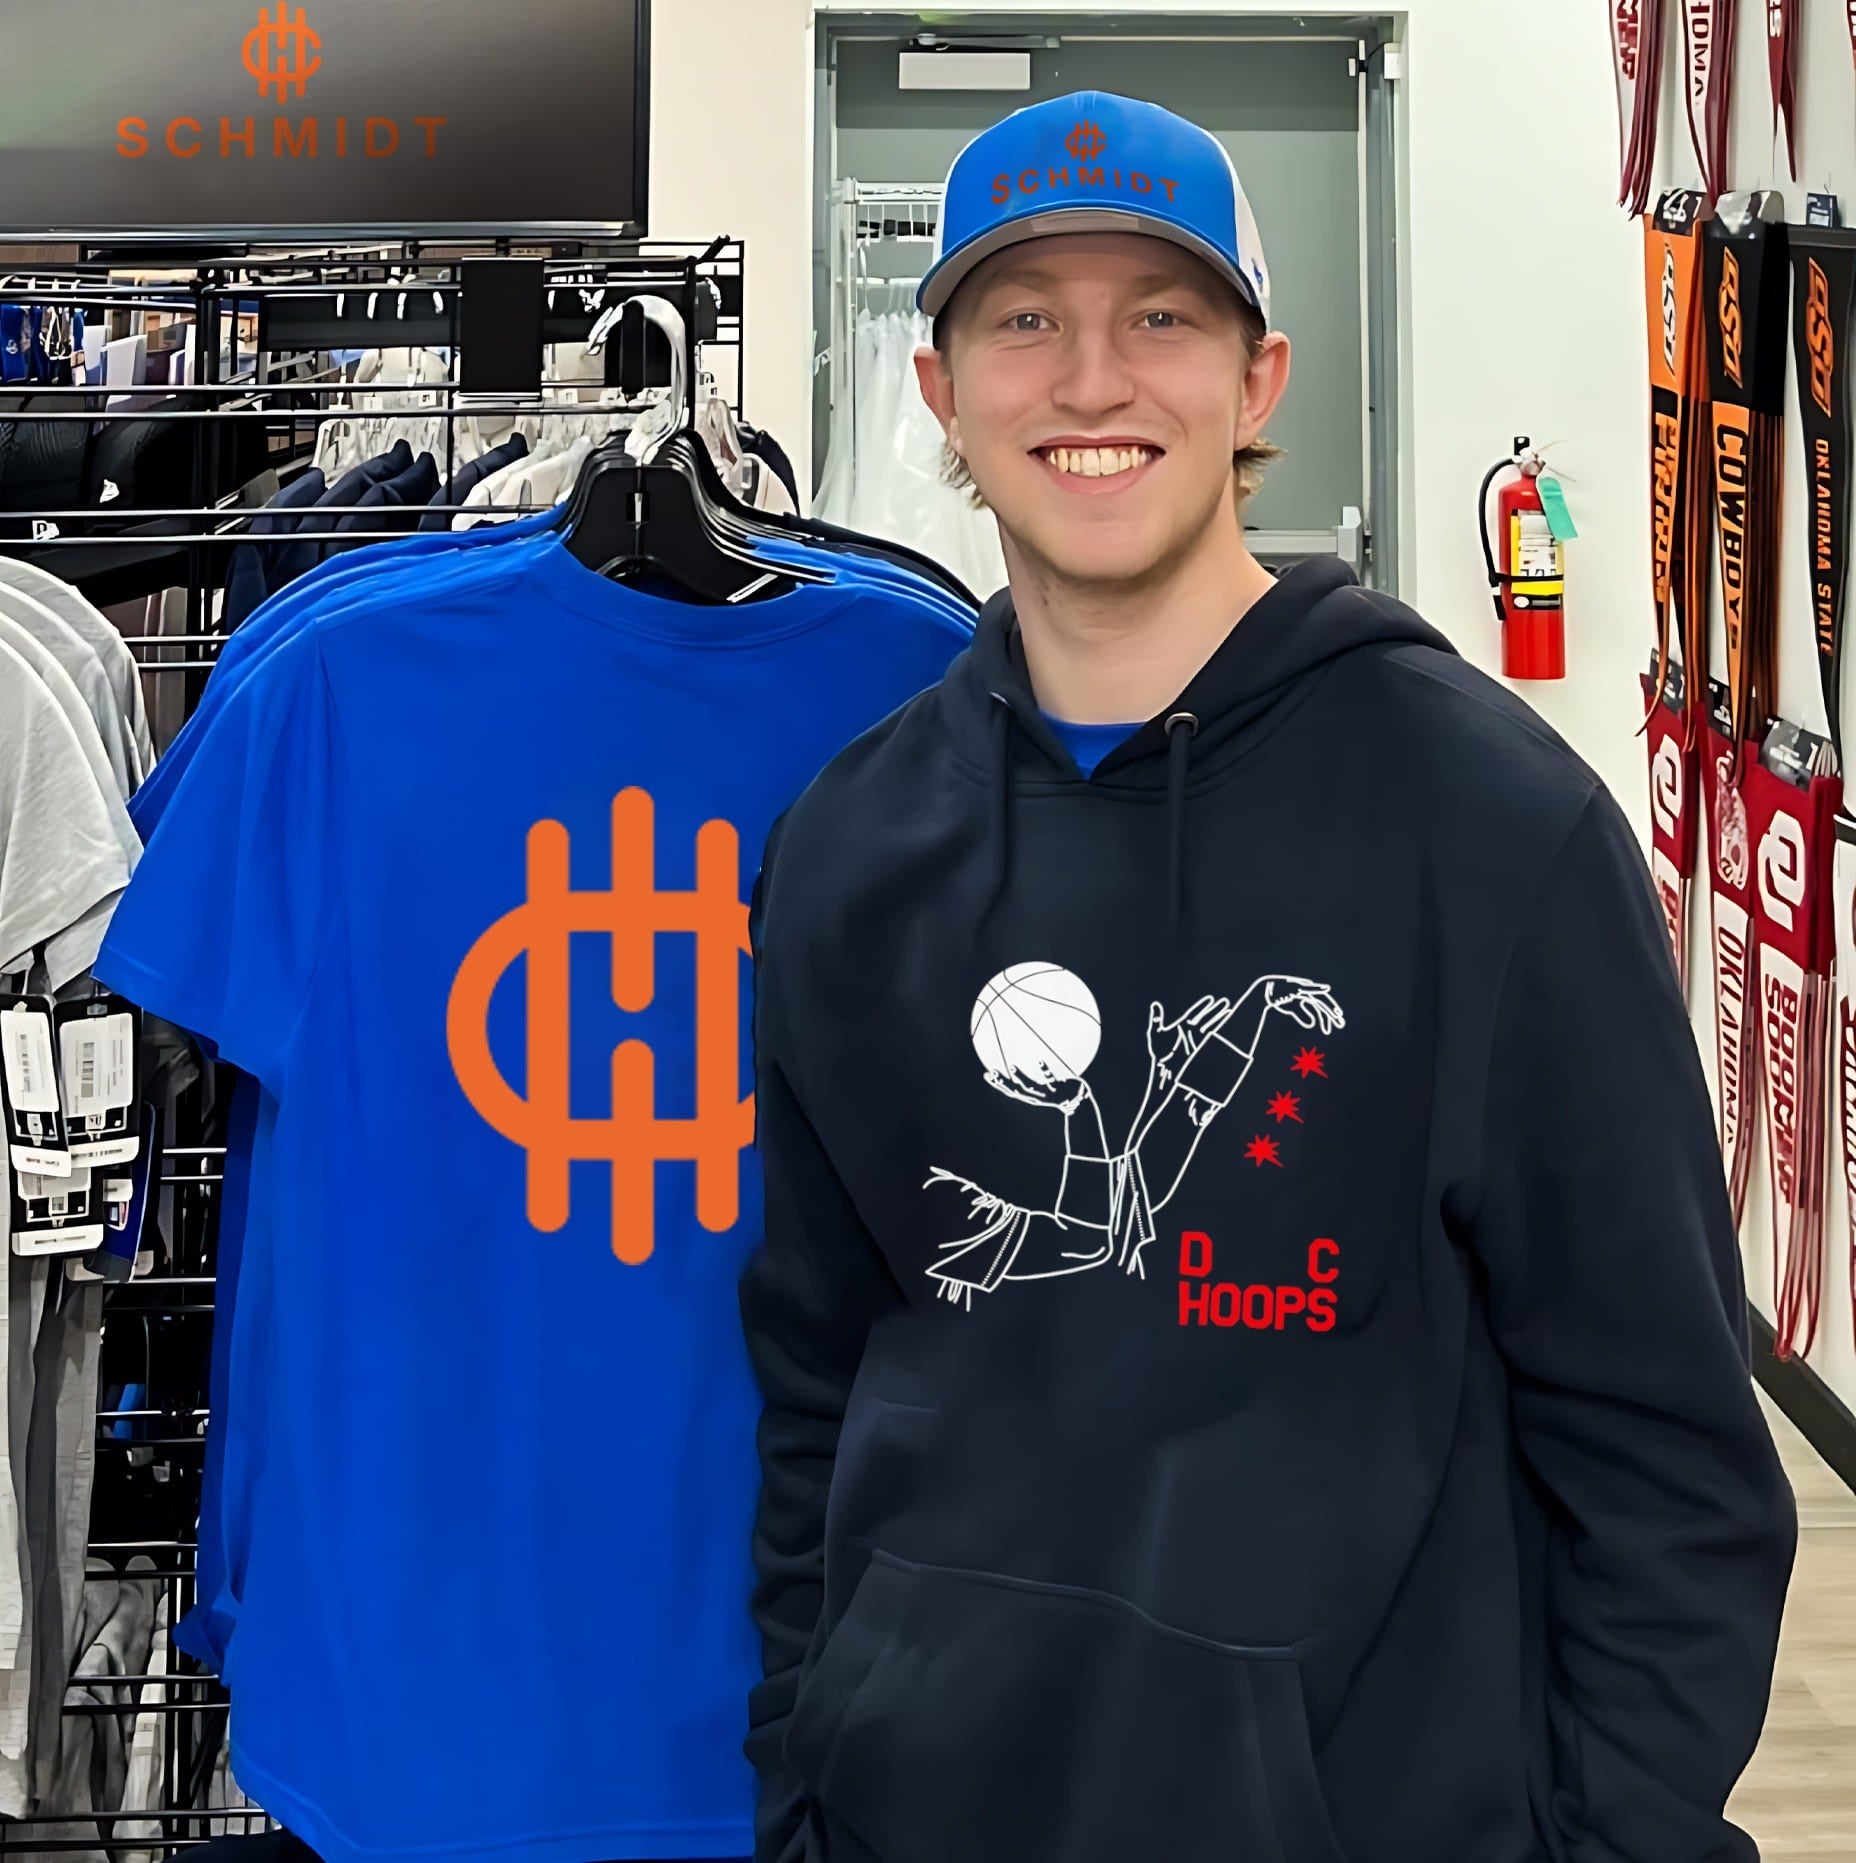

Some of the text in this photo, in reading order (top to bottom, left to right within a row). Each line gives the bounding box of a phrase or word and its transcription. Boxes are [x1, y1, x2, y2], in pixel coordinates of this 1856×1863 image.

[115, 117, 447, 158] SCHMIDT
[992, 166, 1179, 205] SCHMIDT
[1179, 1231, 1340, 1284] D C
[1178, 1281, 1338, 1333] HOOPS
